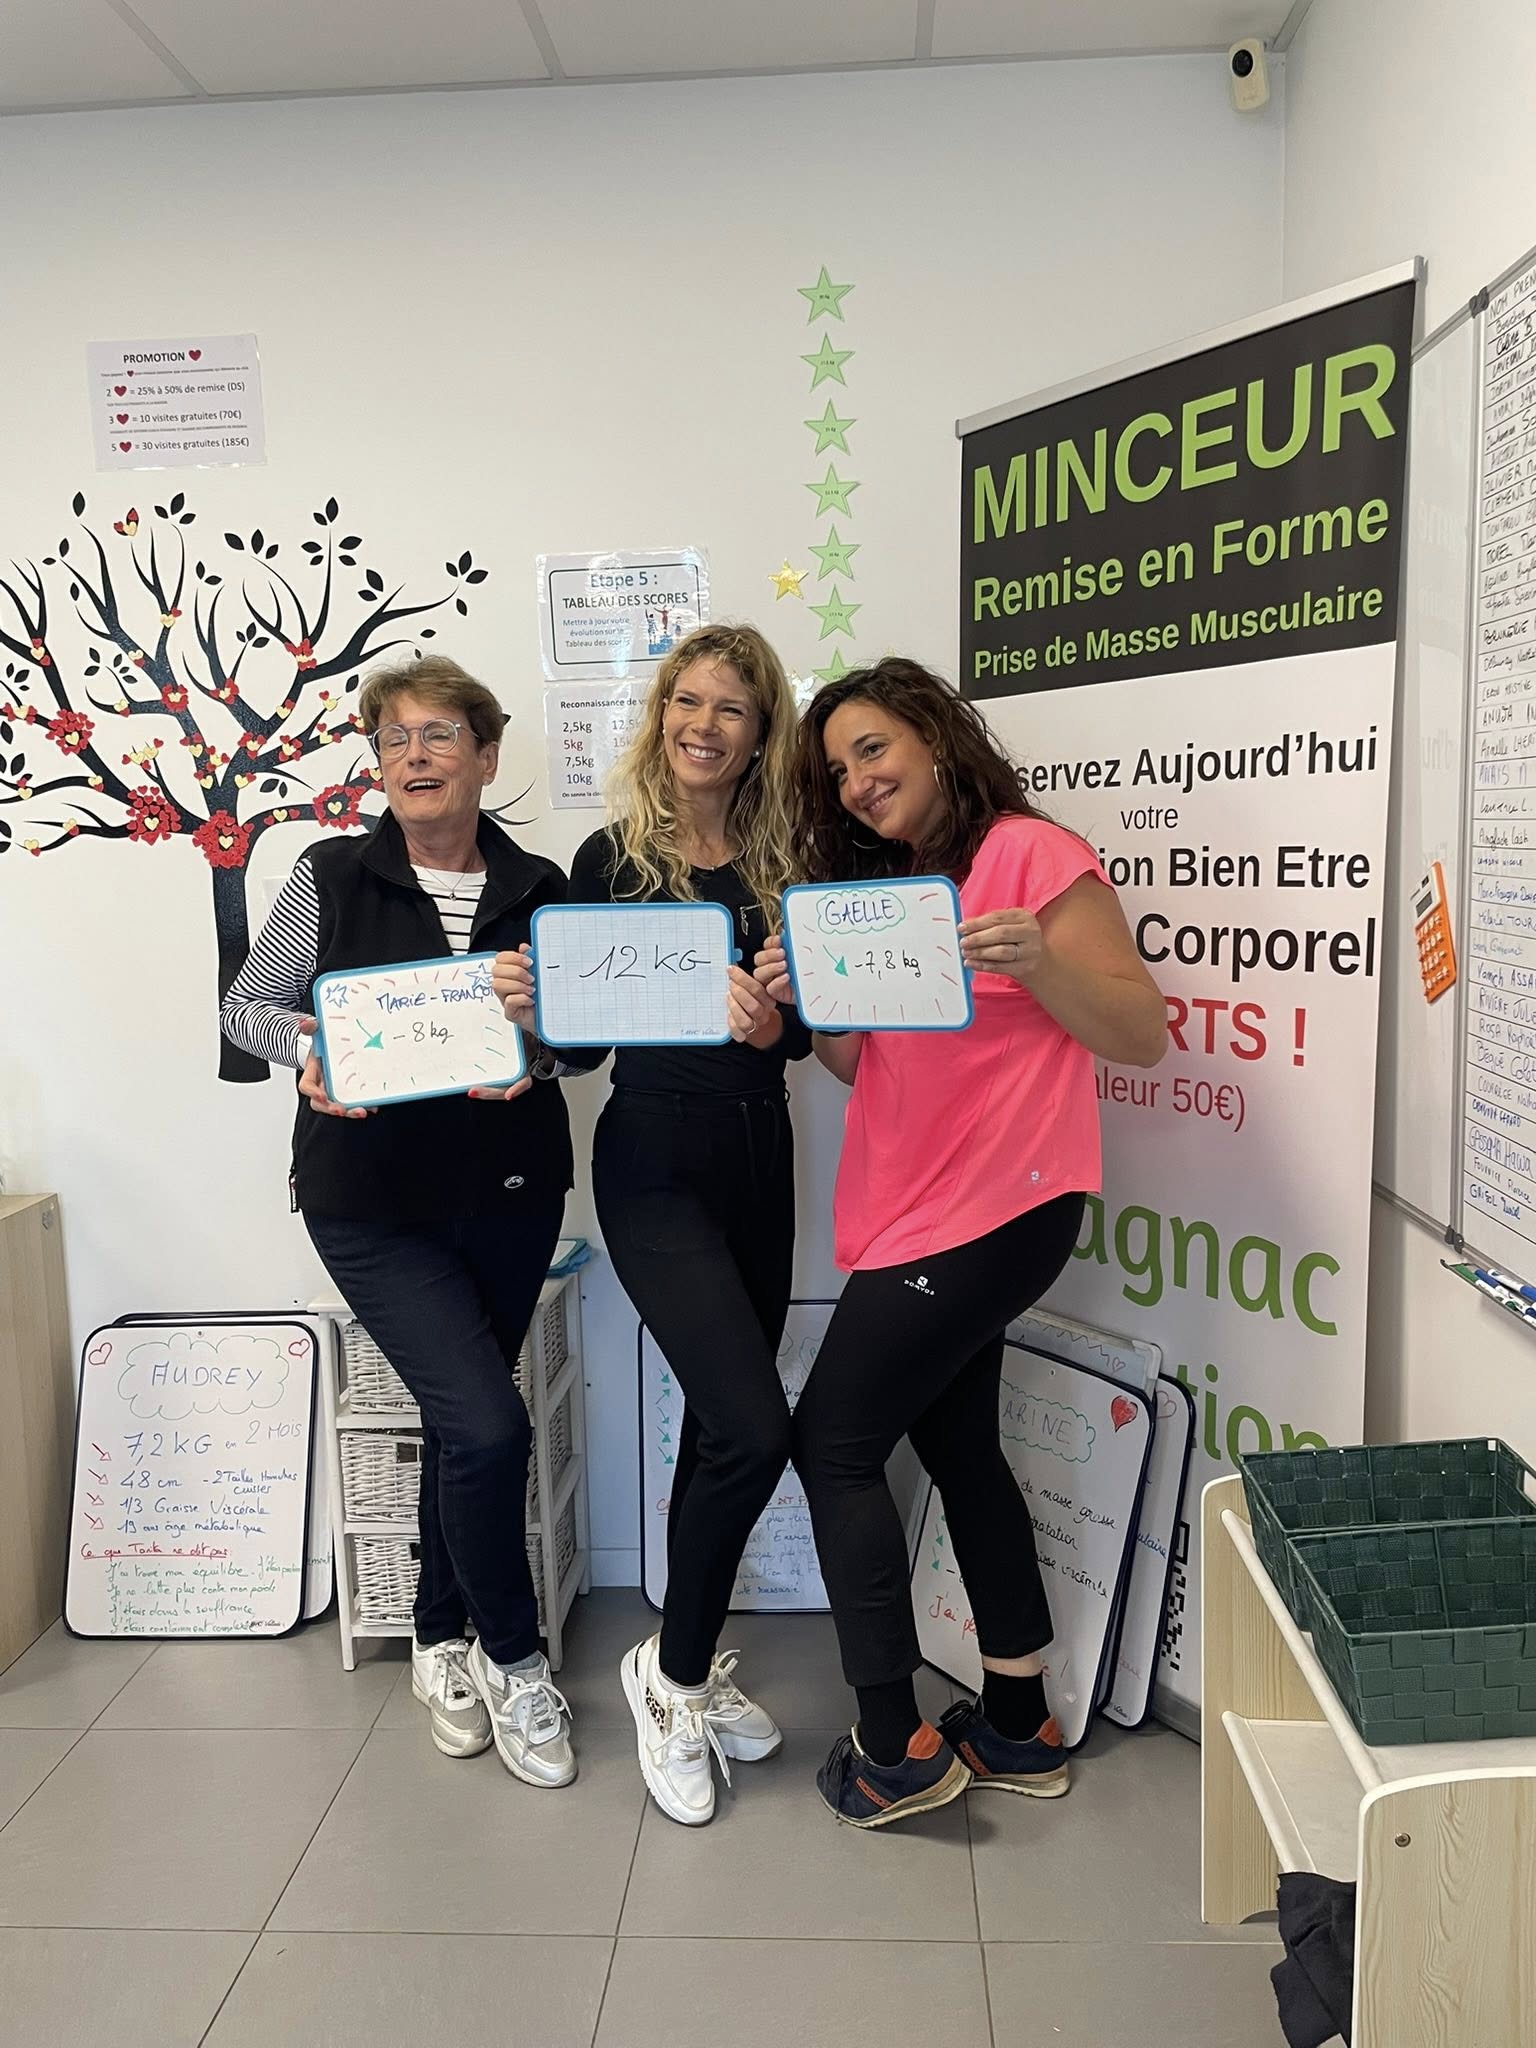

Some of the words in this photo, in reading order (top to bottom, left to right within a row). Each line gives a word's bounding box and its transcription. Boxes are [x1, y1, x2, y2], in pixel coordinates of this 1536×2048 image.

[123, 352, 185, 364] PROMOTION
[106, 388, 111, 397] 2
[137, 386, 156, 395] 25%
[157, 386, 163, 395] à
[164, 385, 183, 394] 50%
[184, 384, 196, 393] de
[197, 384, 226, 392] remise
[227, 381, 245, 392] (DS)
[109, 416, 114, 424] 3
[140, 415, 150, 423] 10
[152, 413, 179, 422] visites
[180, 411, 218, 423] gratuites
[219, 410, 242, 420] (70€)
[112, 443, 117, 451] 5
[142, 442, 153, 450] 30
[154, 440, 181, 449] visites
[183, 438, 220, 450] gratuites
[221, 437, 250, 448] (185€)
[973, 343, 1396, 543] MINCEUR
[973, 557, 1124, 621] Remise
[1138, 542, 1194, 588] en
[1212, 498, 1389, 574] Forme
[591, 573, 634, 590] Etape
[639, 572, 649, 586] 5
[562, 594, 615, 609] TABLEAU
[618, 594, 641, 607] DES
[643, 592, 689, 606] SCORES
[594, 619, 609, 627] jour
[570, 629, 604, 637] évolution
[974, 646, 1037, 679] Prise
[1045, 637, 1077, 668] de
[1085, 621, 1180, 661] Masse
[1190, 586, 1383, 645] Musculaire
[566, 640, 593, 648] Tableau
[560, 699, 625, 709] Reconnaissance
[627, 698, 637, 706] de
[562, 721, 593, 733] 2,5kg
[563, 739, 584, 752] 5kg
[564, 756, 595, 768] 7,5kg
[1131, 726, 1378, 793] Aujourd'hui
[567, 773, 592, 785] 10kg
[1120, 805, 1178, 830] votre
[1169, 846, 1260, 888] Bien
[1276, 846, 1371, 889] Etre
[1135, 912, 1377, 983] Corporel
[579, 945, 646, 980] 12
[903, 949, 922, 978] kg
[412, 1022, 425, 1043] 8
[430, 1020, 454, 1044] kg
[1293, 1007, 1306, 1067] !
[1172, 1078, 1246, 1132] 50€)
[151, 1361, 262, 1391] AUDREY
[124, 1432, 164, 1466] 7,2
[245, 1420, 260, 1444] 2
[120, 1470, 151, 1489] 48
[158, 1479, 182, 1488] cm
[212, 1470, 223, 1484] 2
[120, 1497, 143, 1514] 1/3
[154, 1497, 199, 1513] Graisse
[117, 1519, 137, 1533] 19
